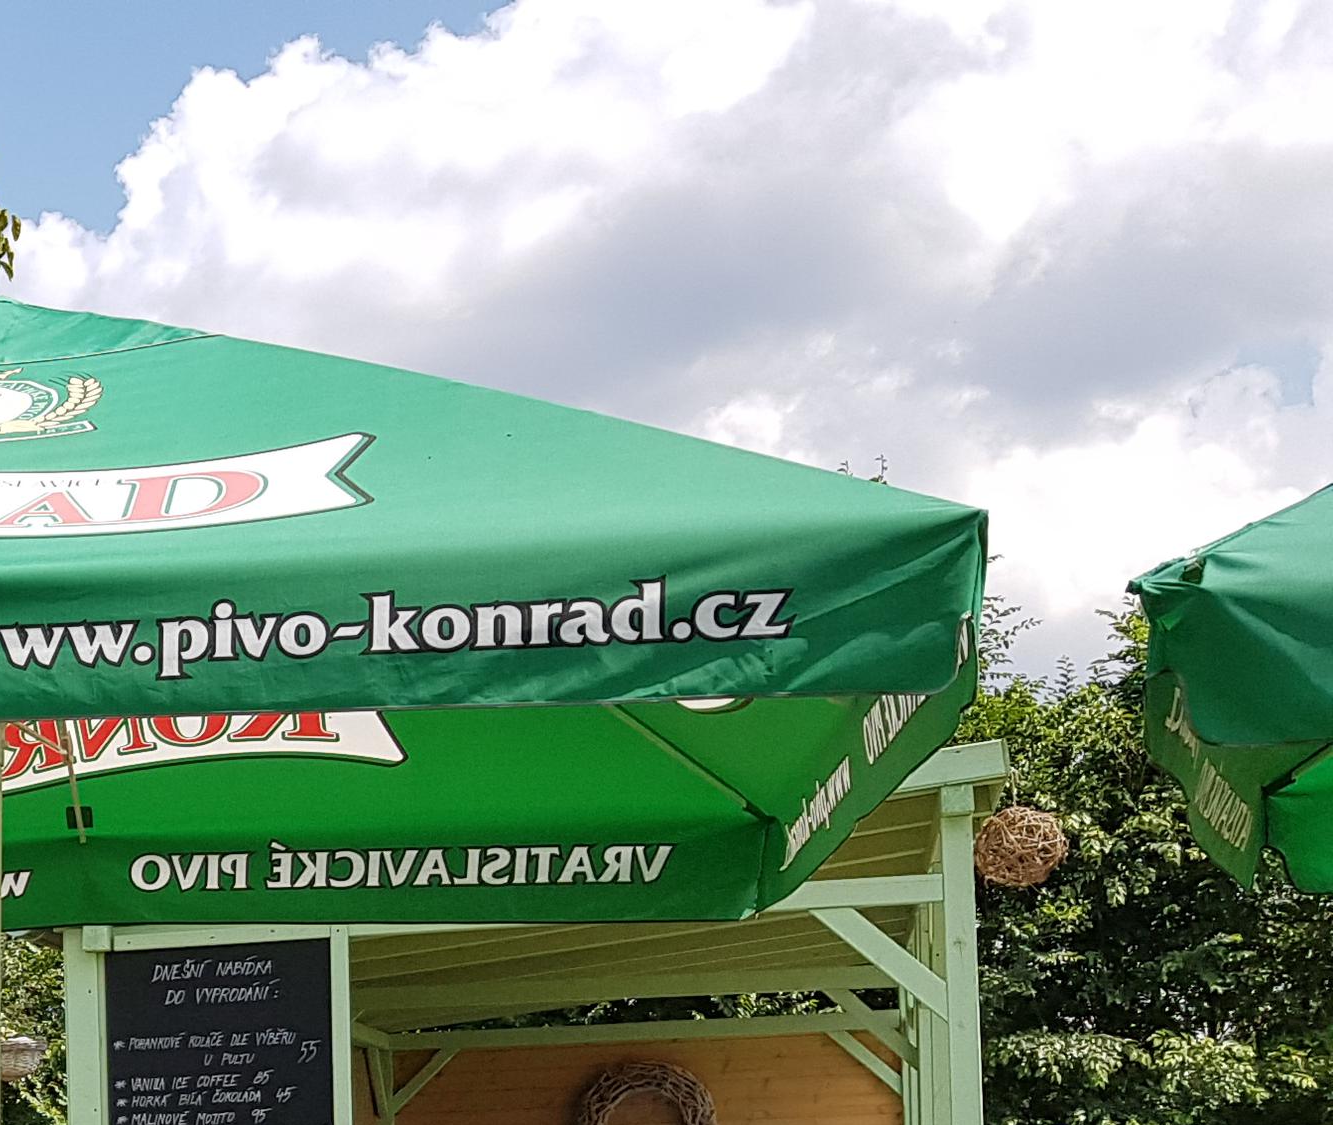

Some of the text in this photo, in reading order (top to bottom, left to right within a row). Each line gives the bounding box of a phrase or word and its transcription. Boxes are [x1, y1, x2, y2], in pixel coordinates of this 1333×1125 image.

[151, 958, 213, 984] DNEŠNÍ
[164, 989, 186, 1006] DO
[230, 1034, 248, 1046] DLE
[204, 1039, 323, 1066] U PULTU 55
[171, 1076, 192, 1090] ICE
[197, 1073, 242, 1087] COFFEE
[275, 1086, 298, 1103] 45
[195, 1112, 236, 1125] MOJITO
[251, 1107, 274, 1125] 95
